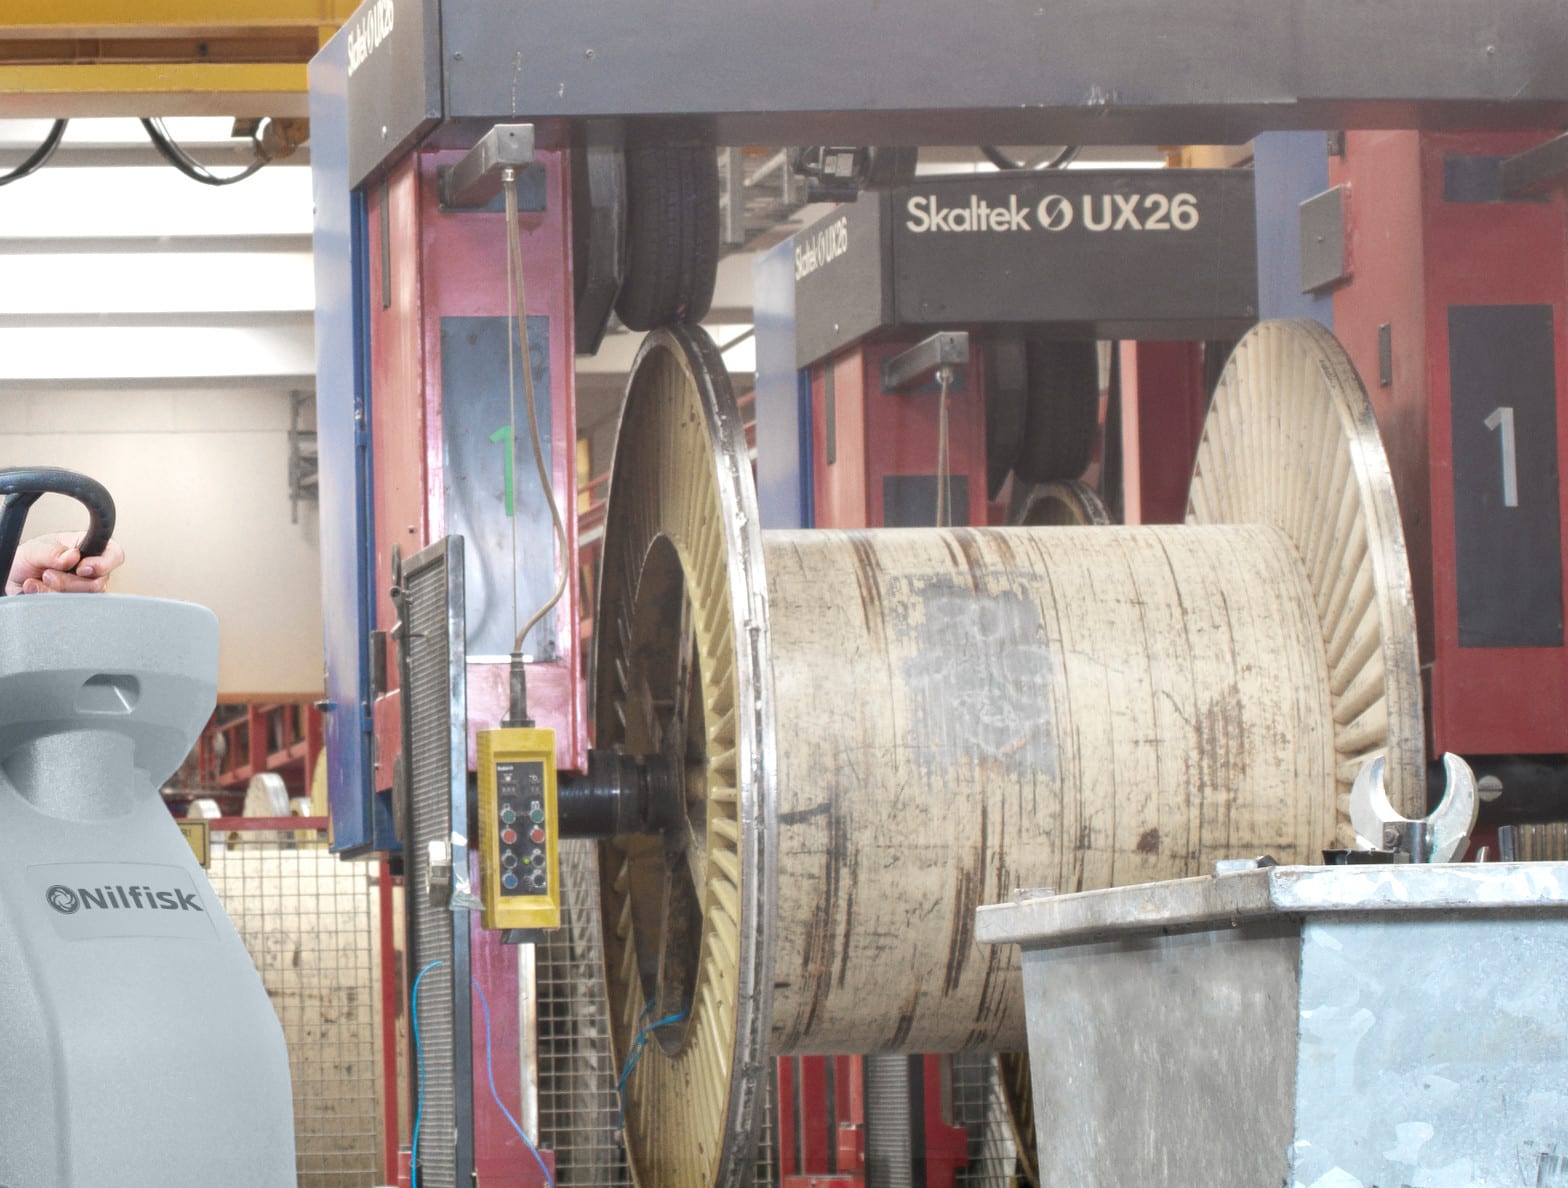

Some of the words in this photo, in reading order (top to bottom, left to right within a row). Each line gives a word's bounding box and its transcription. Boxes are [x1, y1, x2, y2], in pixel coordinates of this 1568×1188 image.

[906, 194, 1032, 232] Skaltek
[1082, 193, 1200, 232] UX26
[488, 425, 513, 517] 1
[1484, 406, 1519, 507] 1
[77, 885, 204, 912] Nilfisk
